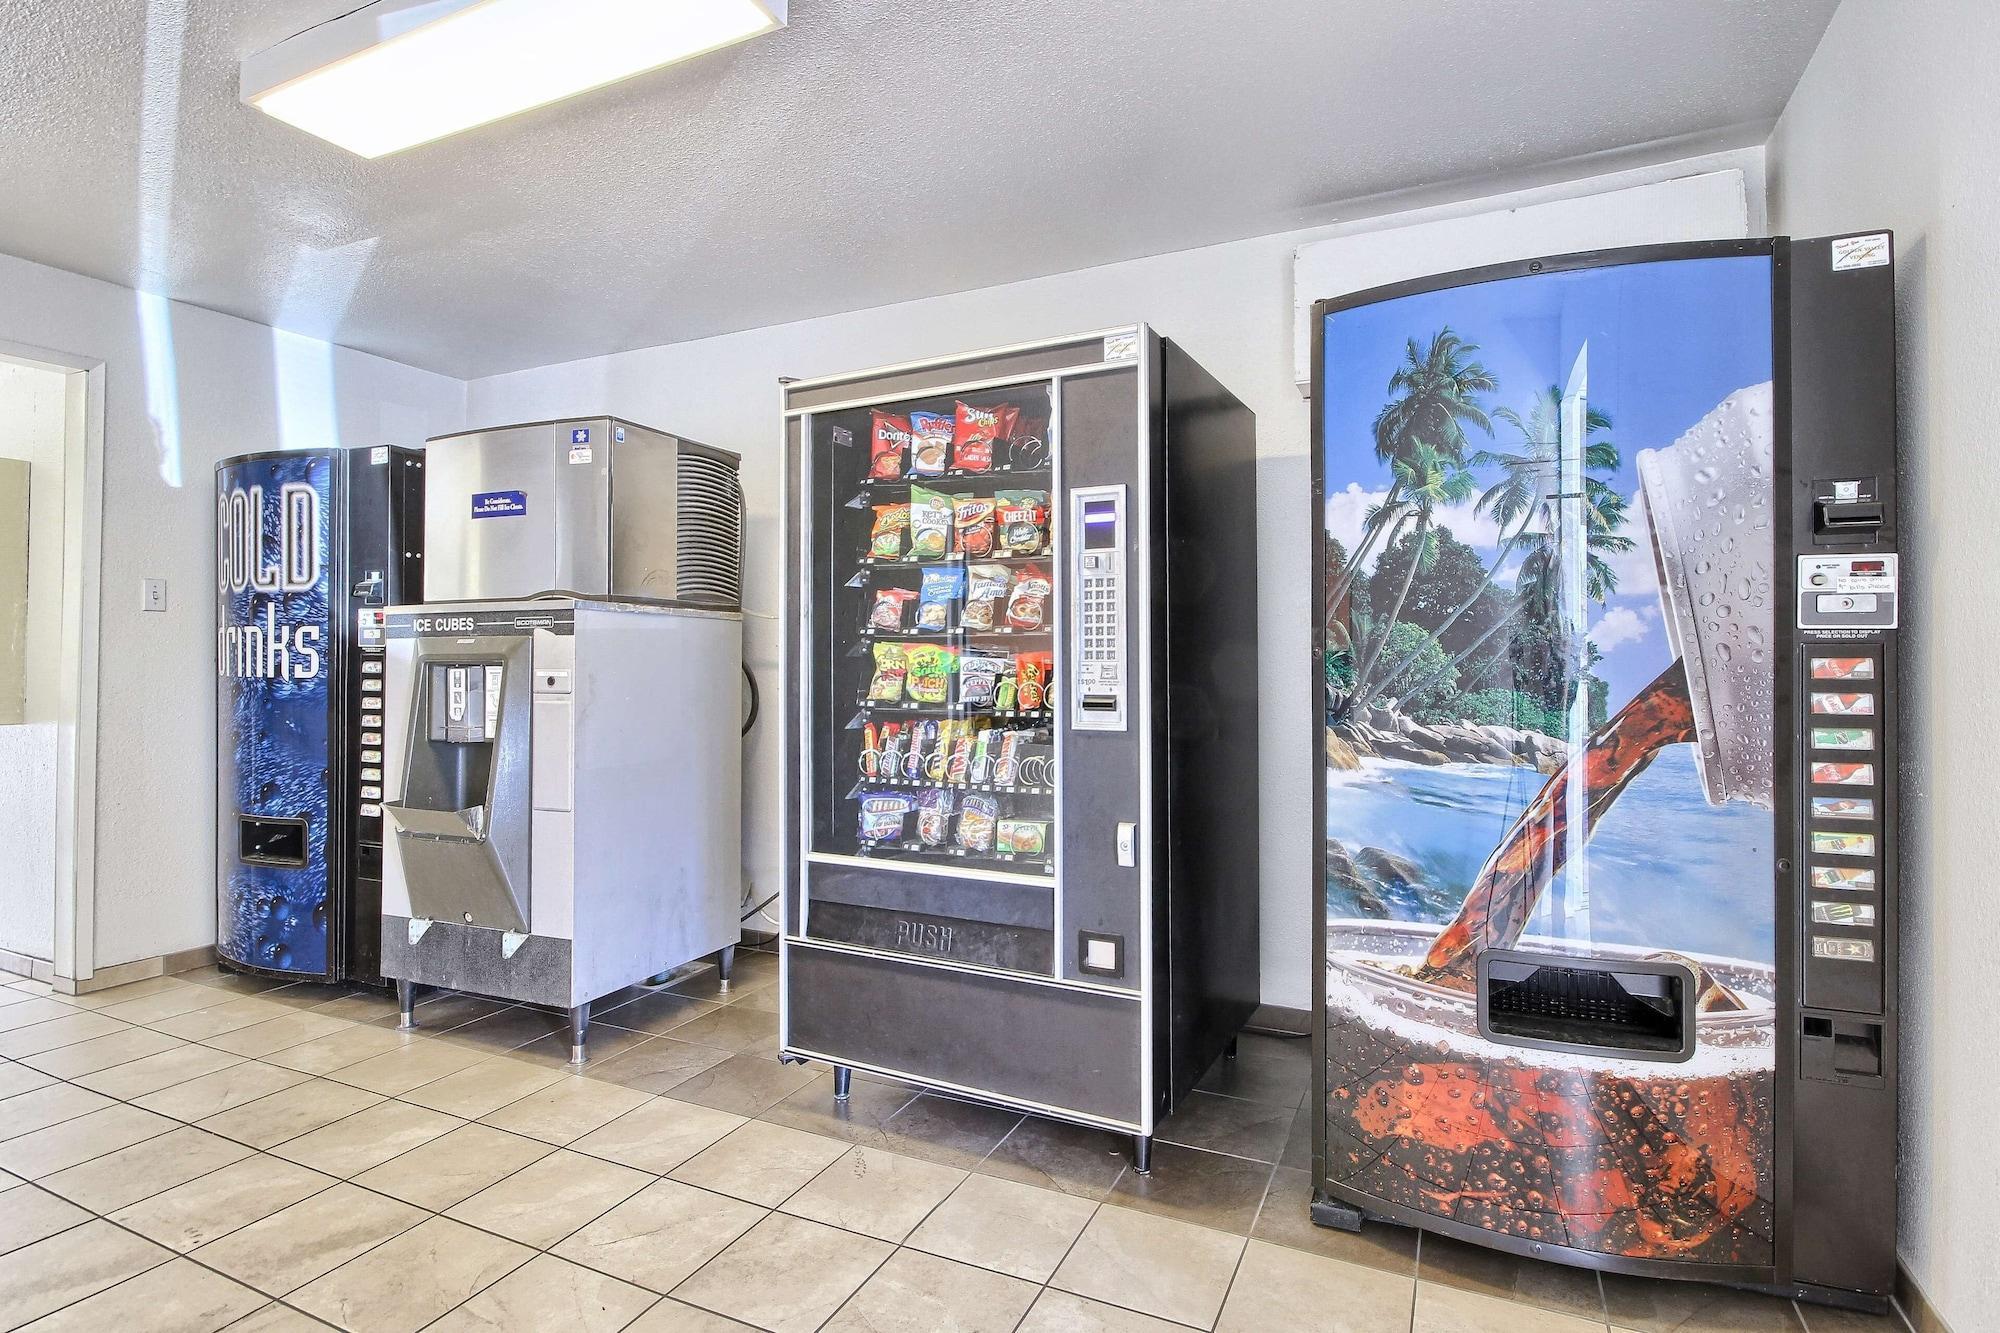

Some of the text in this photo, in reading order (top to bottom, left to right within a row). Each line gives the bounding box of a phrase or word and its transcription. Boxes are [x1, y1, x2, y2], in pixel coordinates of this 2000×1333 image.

[965, 407, 994, 423] Sun
[878, 429, 912, 442] Dorito
[956, 502, 988, 520] Fritos
[1003, 509, 1038, 523] CHEEZ-IT
[217, 482, 321, 595] COLD
[413, 617, 475, 632] ICE CUBES
[217, 602, 321, 684] drinks
[897, 920, 953, 952] PUSH
